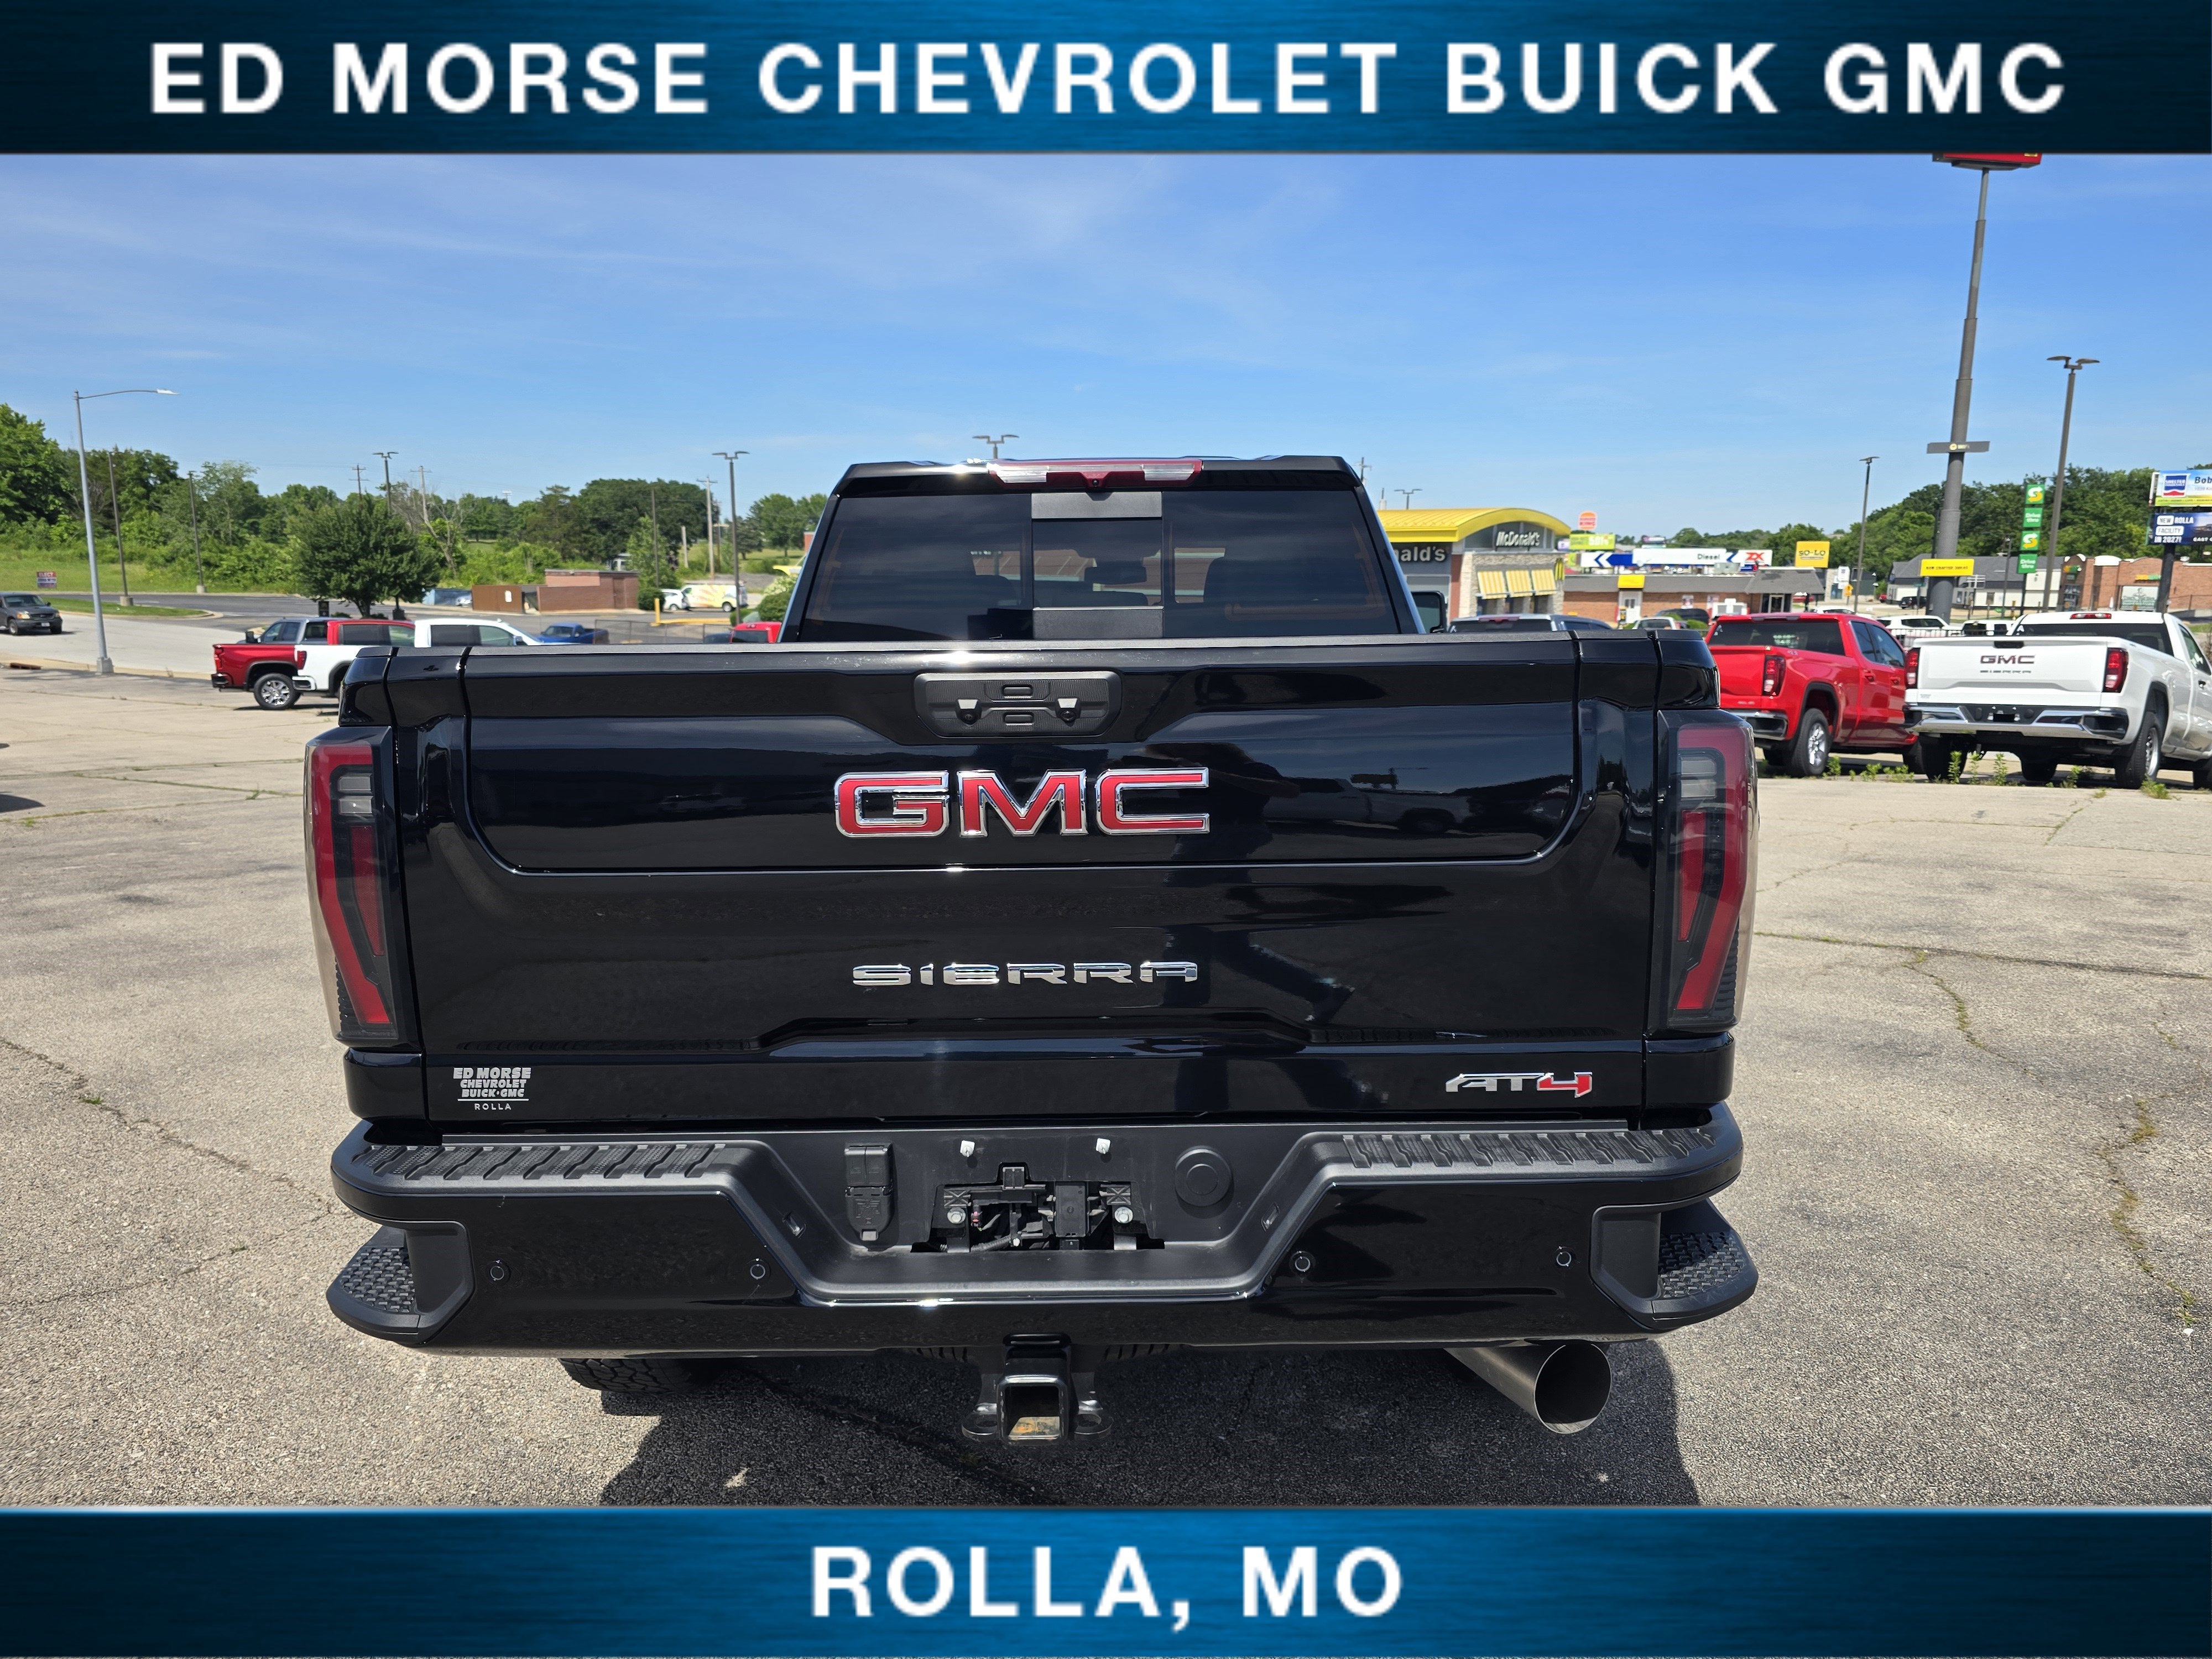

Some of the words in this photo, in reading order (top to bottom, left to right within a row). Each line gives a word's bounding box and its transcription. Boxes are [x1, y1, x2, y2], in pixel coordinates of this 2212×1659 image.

[1496, 531, 1540, 546] McDonald's
[1980, 655, 2036, 664] GMC
[834, 767, 1209, 837] GMC
[853, 962, 1198, 985] SIERRA
[453, 1067, 473, 1079] ED
[477, 1067, 531, 1079] MORSE
[460, 1079, 527, 1088] CHEVROLET
[1446, 1072, 1593, 1098] AT4
